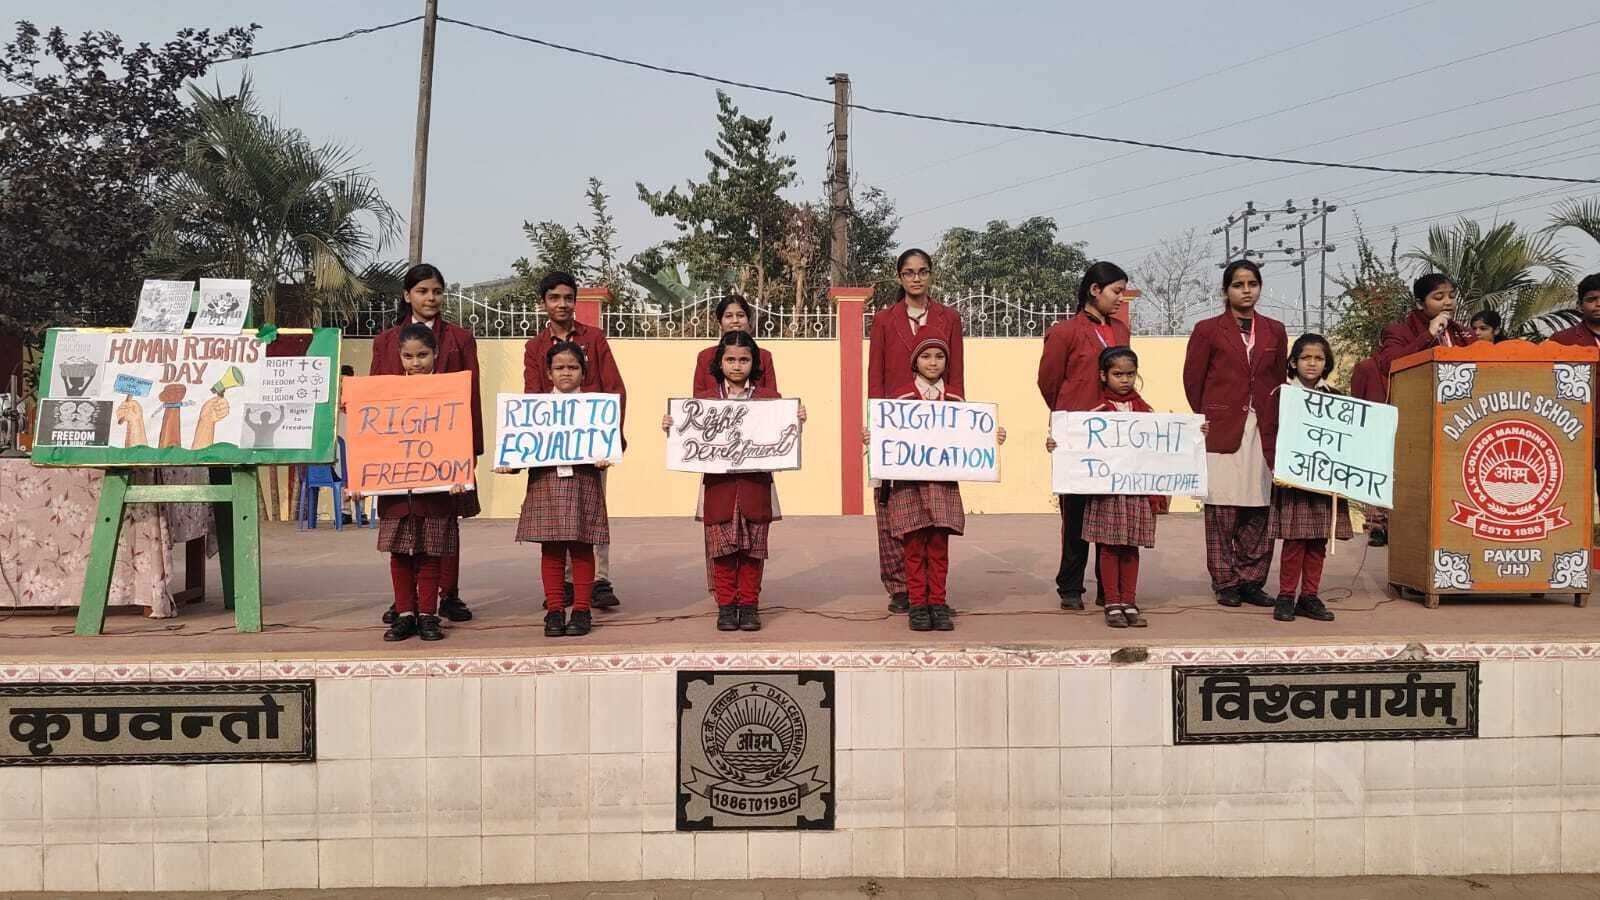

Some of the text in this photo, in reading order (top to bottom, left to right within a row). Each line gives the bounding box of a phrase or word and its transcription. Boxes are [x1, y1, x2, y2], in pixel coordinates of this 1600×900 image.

[107, 336, 260, 364] HUMAN RIGHTS
[266, 359, 294, 368] RIGHT
[159, 362, 208, 384] DAY
[274, 369, 285, 377] TO
[359, 402, 464, 434] RIGHT
[504, 399, 617, 427] RIGHT TO
[678, 399, 749, 441] Right
[878, 401, 994, 434] RIGHT TO
[1303, 389, 1371, 427] सुरक्षा
[1443, 390, 1585, 442] D.A.V. PUBLIC SCHOOL
[51, 431, 95, 441] FREEDOM
[399, 440, 433, 459] TO
[499, 428, 618, 465] EQUALITY
[682, 423, 799, 467] Development
[1083, 417, 1187, 453] RIGHT
[1303, 422, 1352, 452] का
[882, 439, 995, 469] EDUCATION
[1467, 433, 1494, 473] COLLEGE
[1495, 427, 1547, 449] MANAGING
[1537, 447, 1558, 506] COMMITTEE
[361, 459, 472, 487] FREEDOM
[1081, 459, 1200, 493] TO PARTICIPATE
[1289, 450, 1388, 498] अधिकार
[1479, 523, 1542, 536] ESTD 1886
[1484, 549, 1542, 562] PAKUR
[1497, 563, 1530, 577] (JH)
[1199, 673, 1458, 726] विश्वमार्यम्
[9, 694, 284, 755] कृण्वन्तो
[787, 705, 804, 758] CENTENARY
